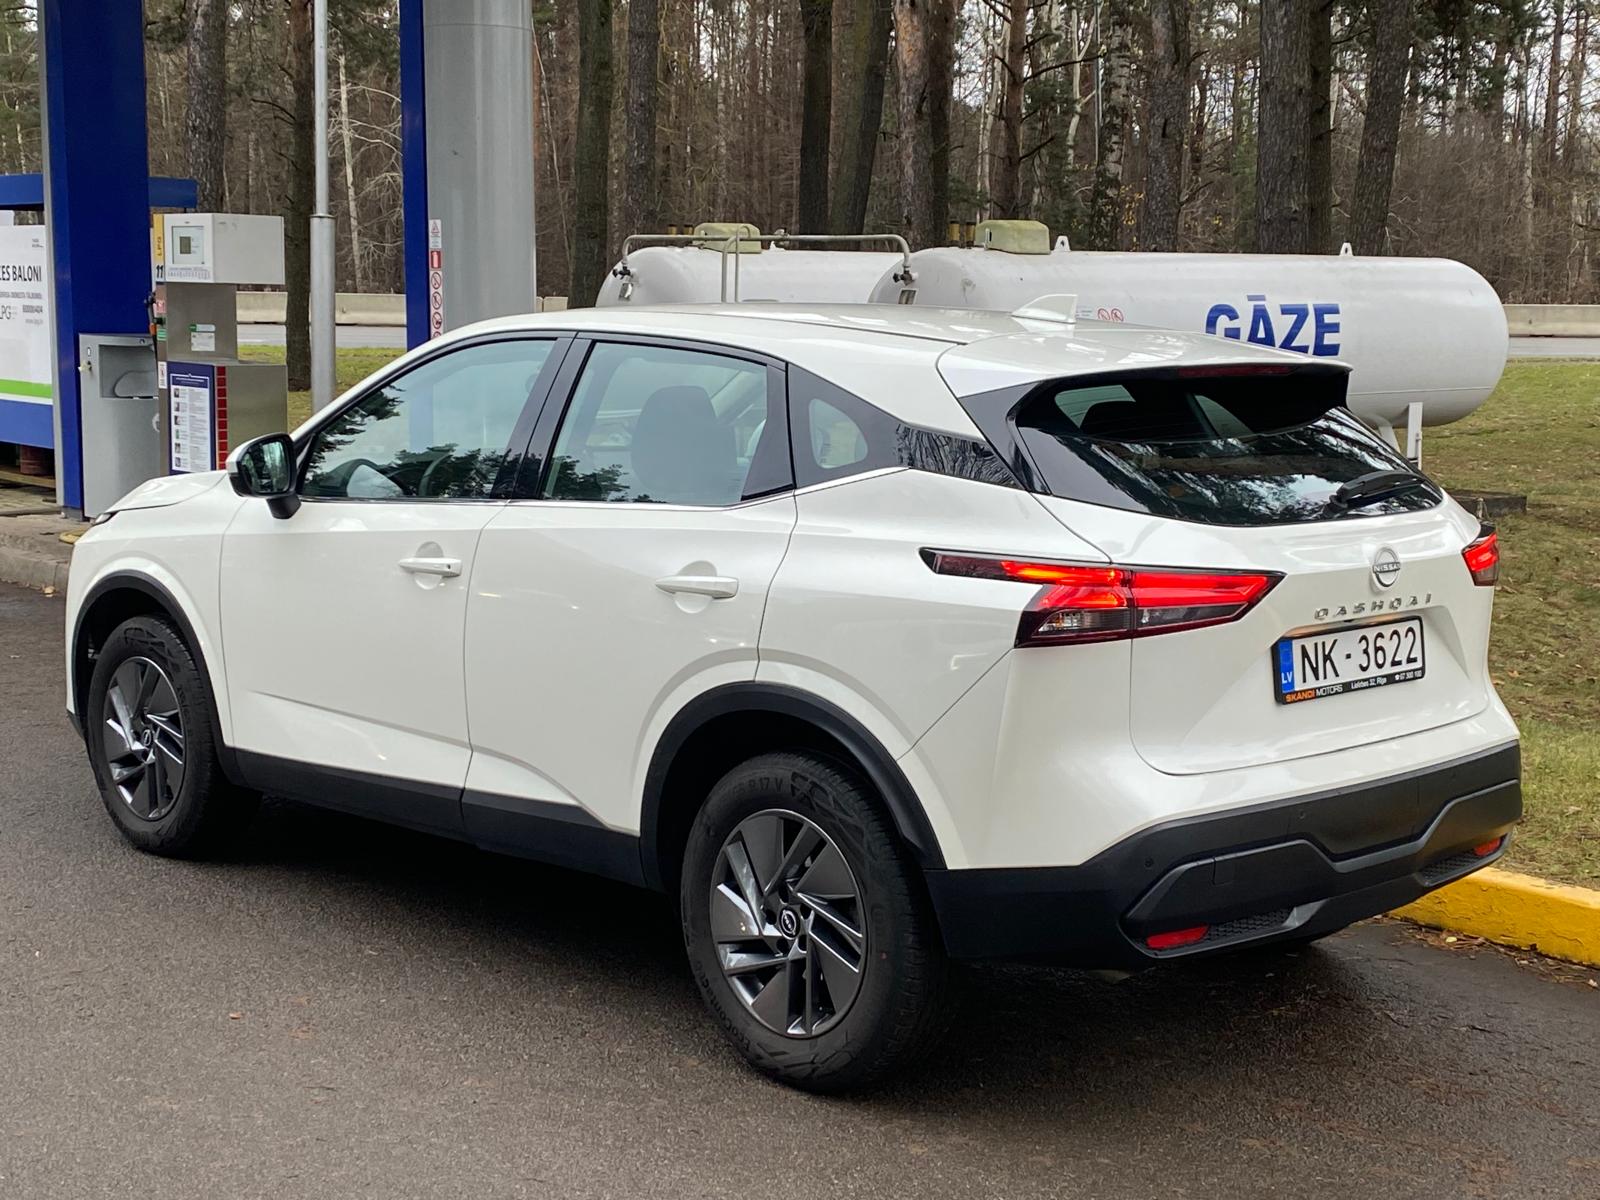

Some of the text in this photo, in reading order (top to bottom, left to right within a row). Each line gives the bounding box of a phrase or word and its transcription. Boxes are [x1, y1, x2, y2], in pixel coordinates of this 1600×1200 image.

[0, 265, 42, 282] ES BALONI
[156, 265, 164, 279] 11
[1205, 295, 1340, 357] GĀZE
[1314, 593, 1432, 620] QASHQAI
[1300, 626, 1418, 684] NK-3622
[1281, 671, 1293, 684] LV
[1285, 684, 1343, 702] SKANDI MOTORS
